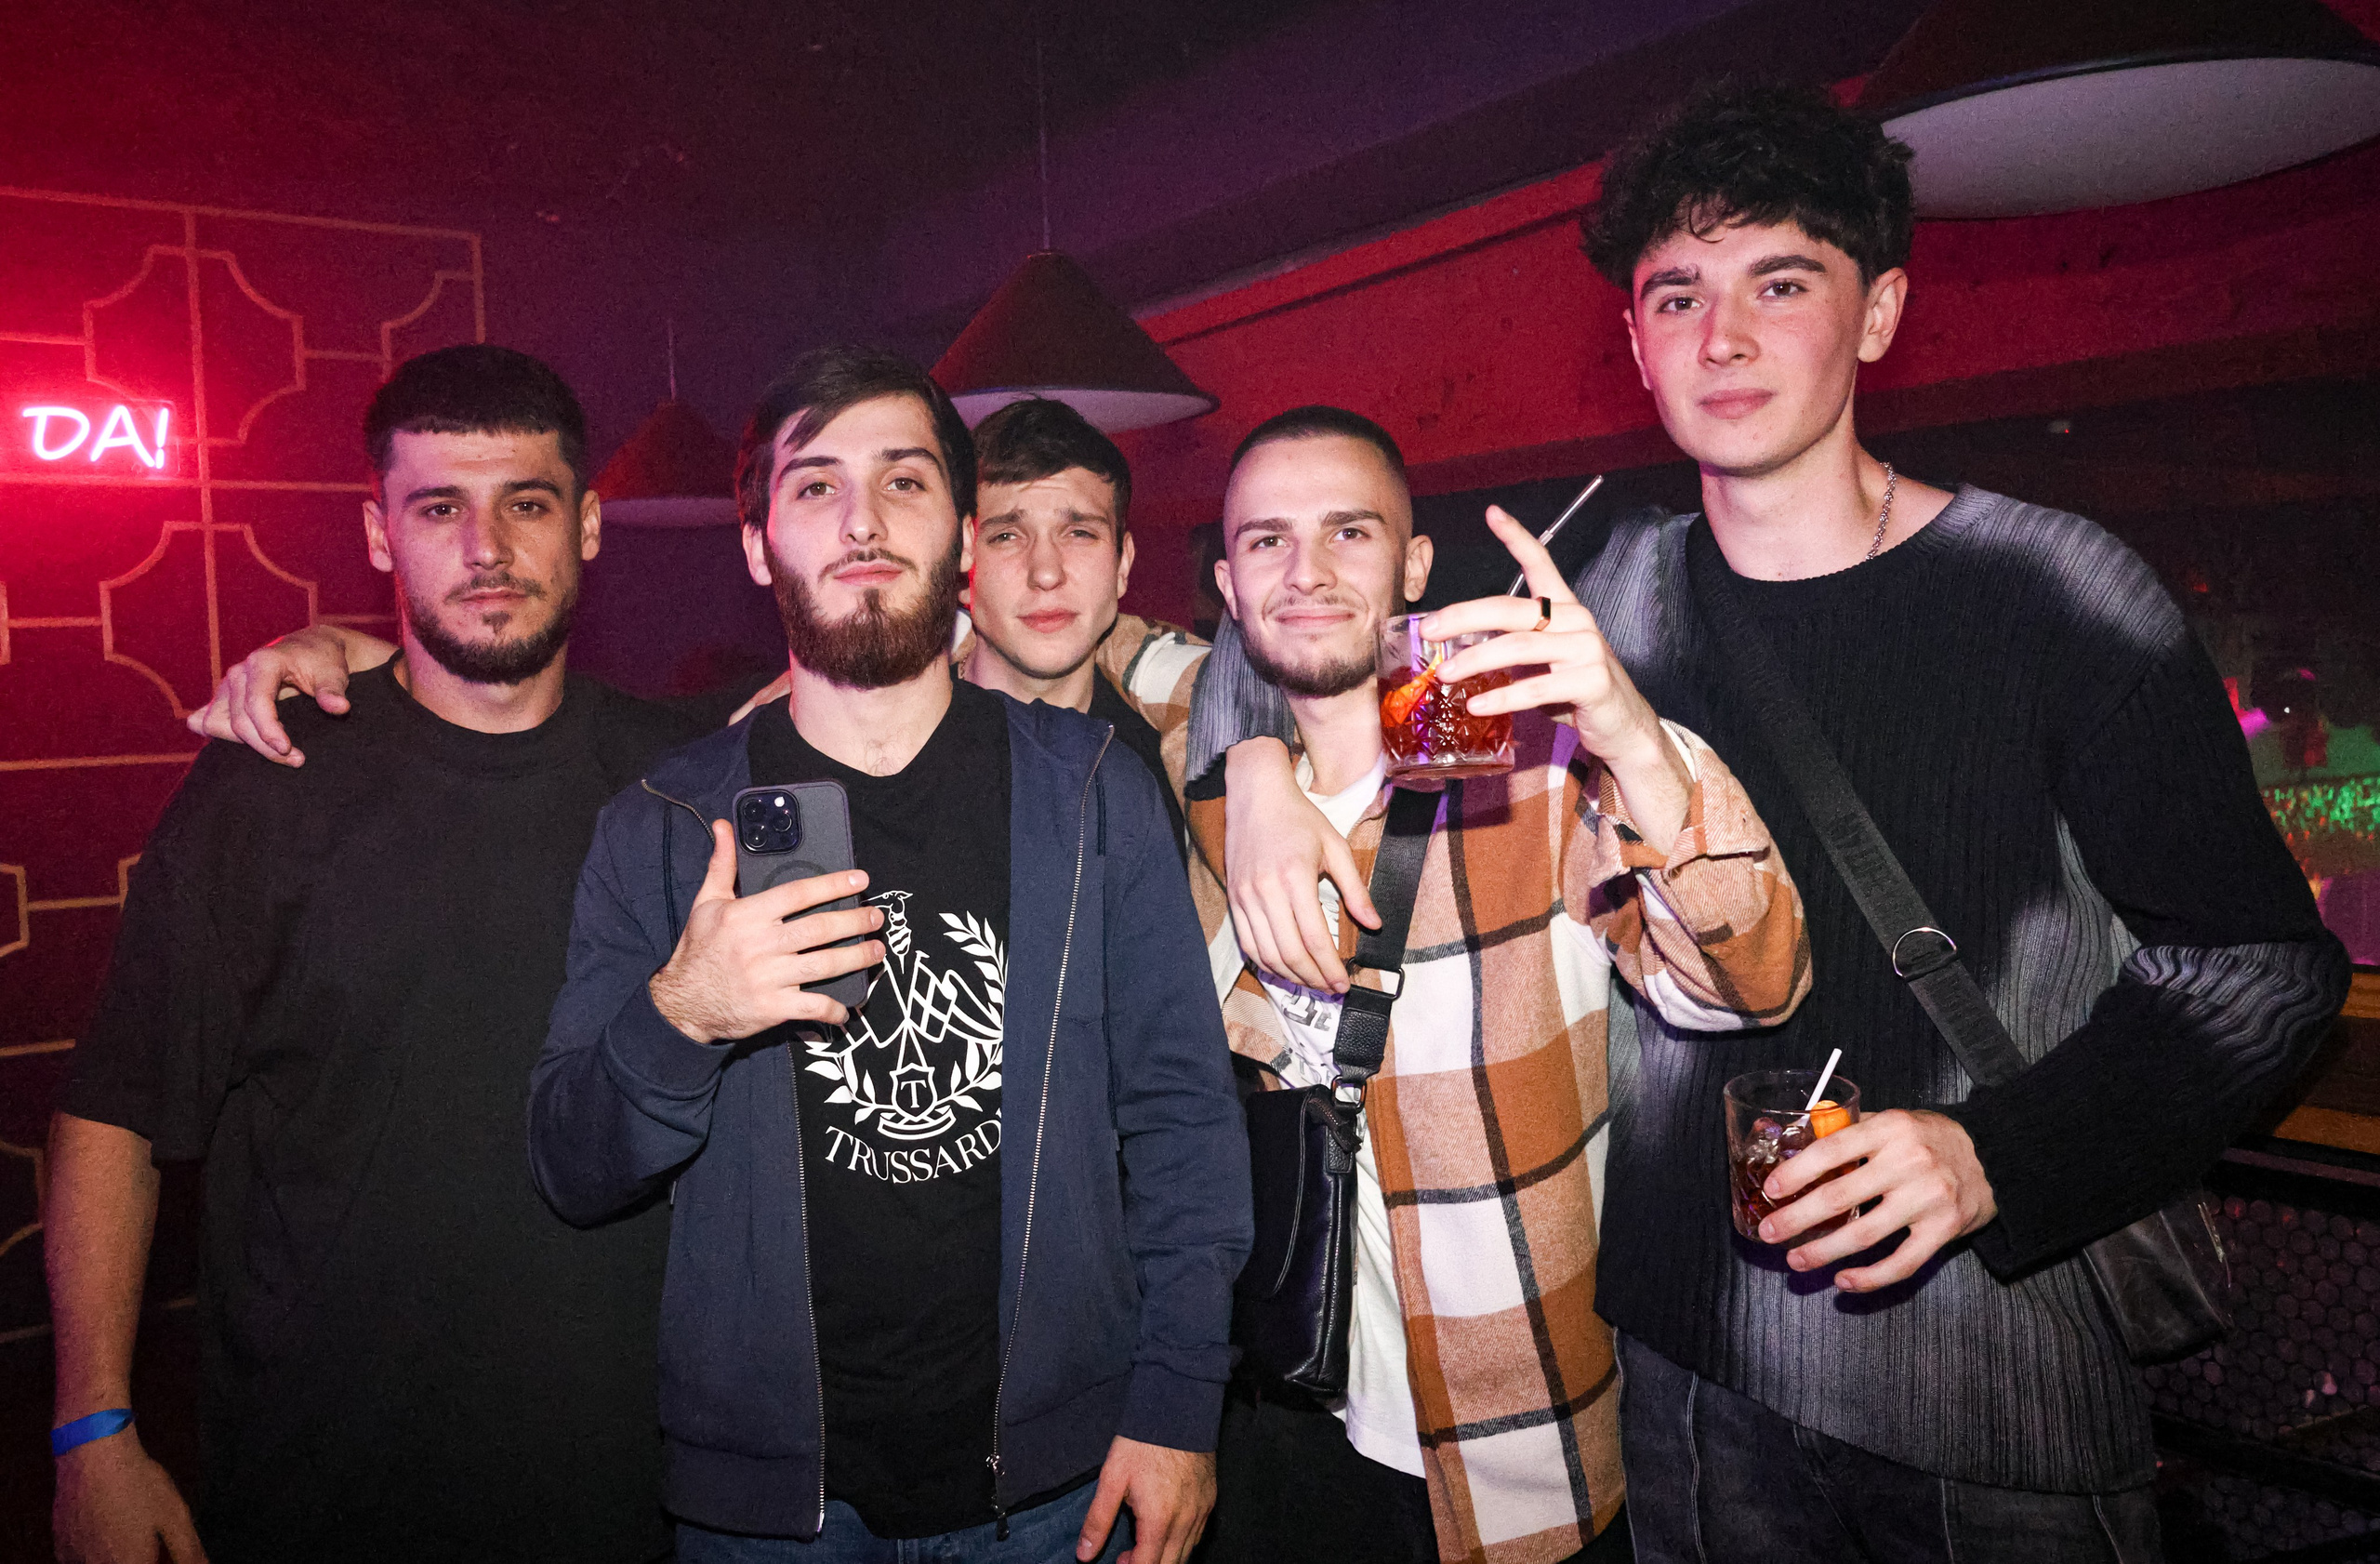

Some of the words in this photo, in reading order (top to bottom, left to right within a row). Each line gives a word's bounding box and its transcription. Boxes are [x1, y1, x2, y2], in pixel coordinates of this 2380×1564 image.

[22, 404, 168, 469] DA!
[901, 1080, 927, 1108] T
[825, 1107, 1002, 1184] TRUSSARD
